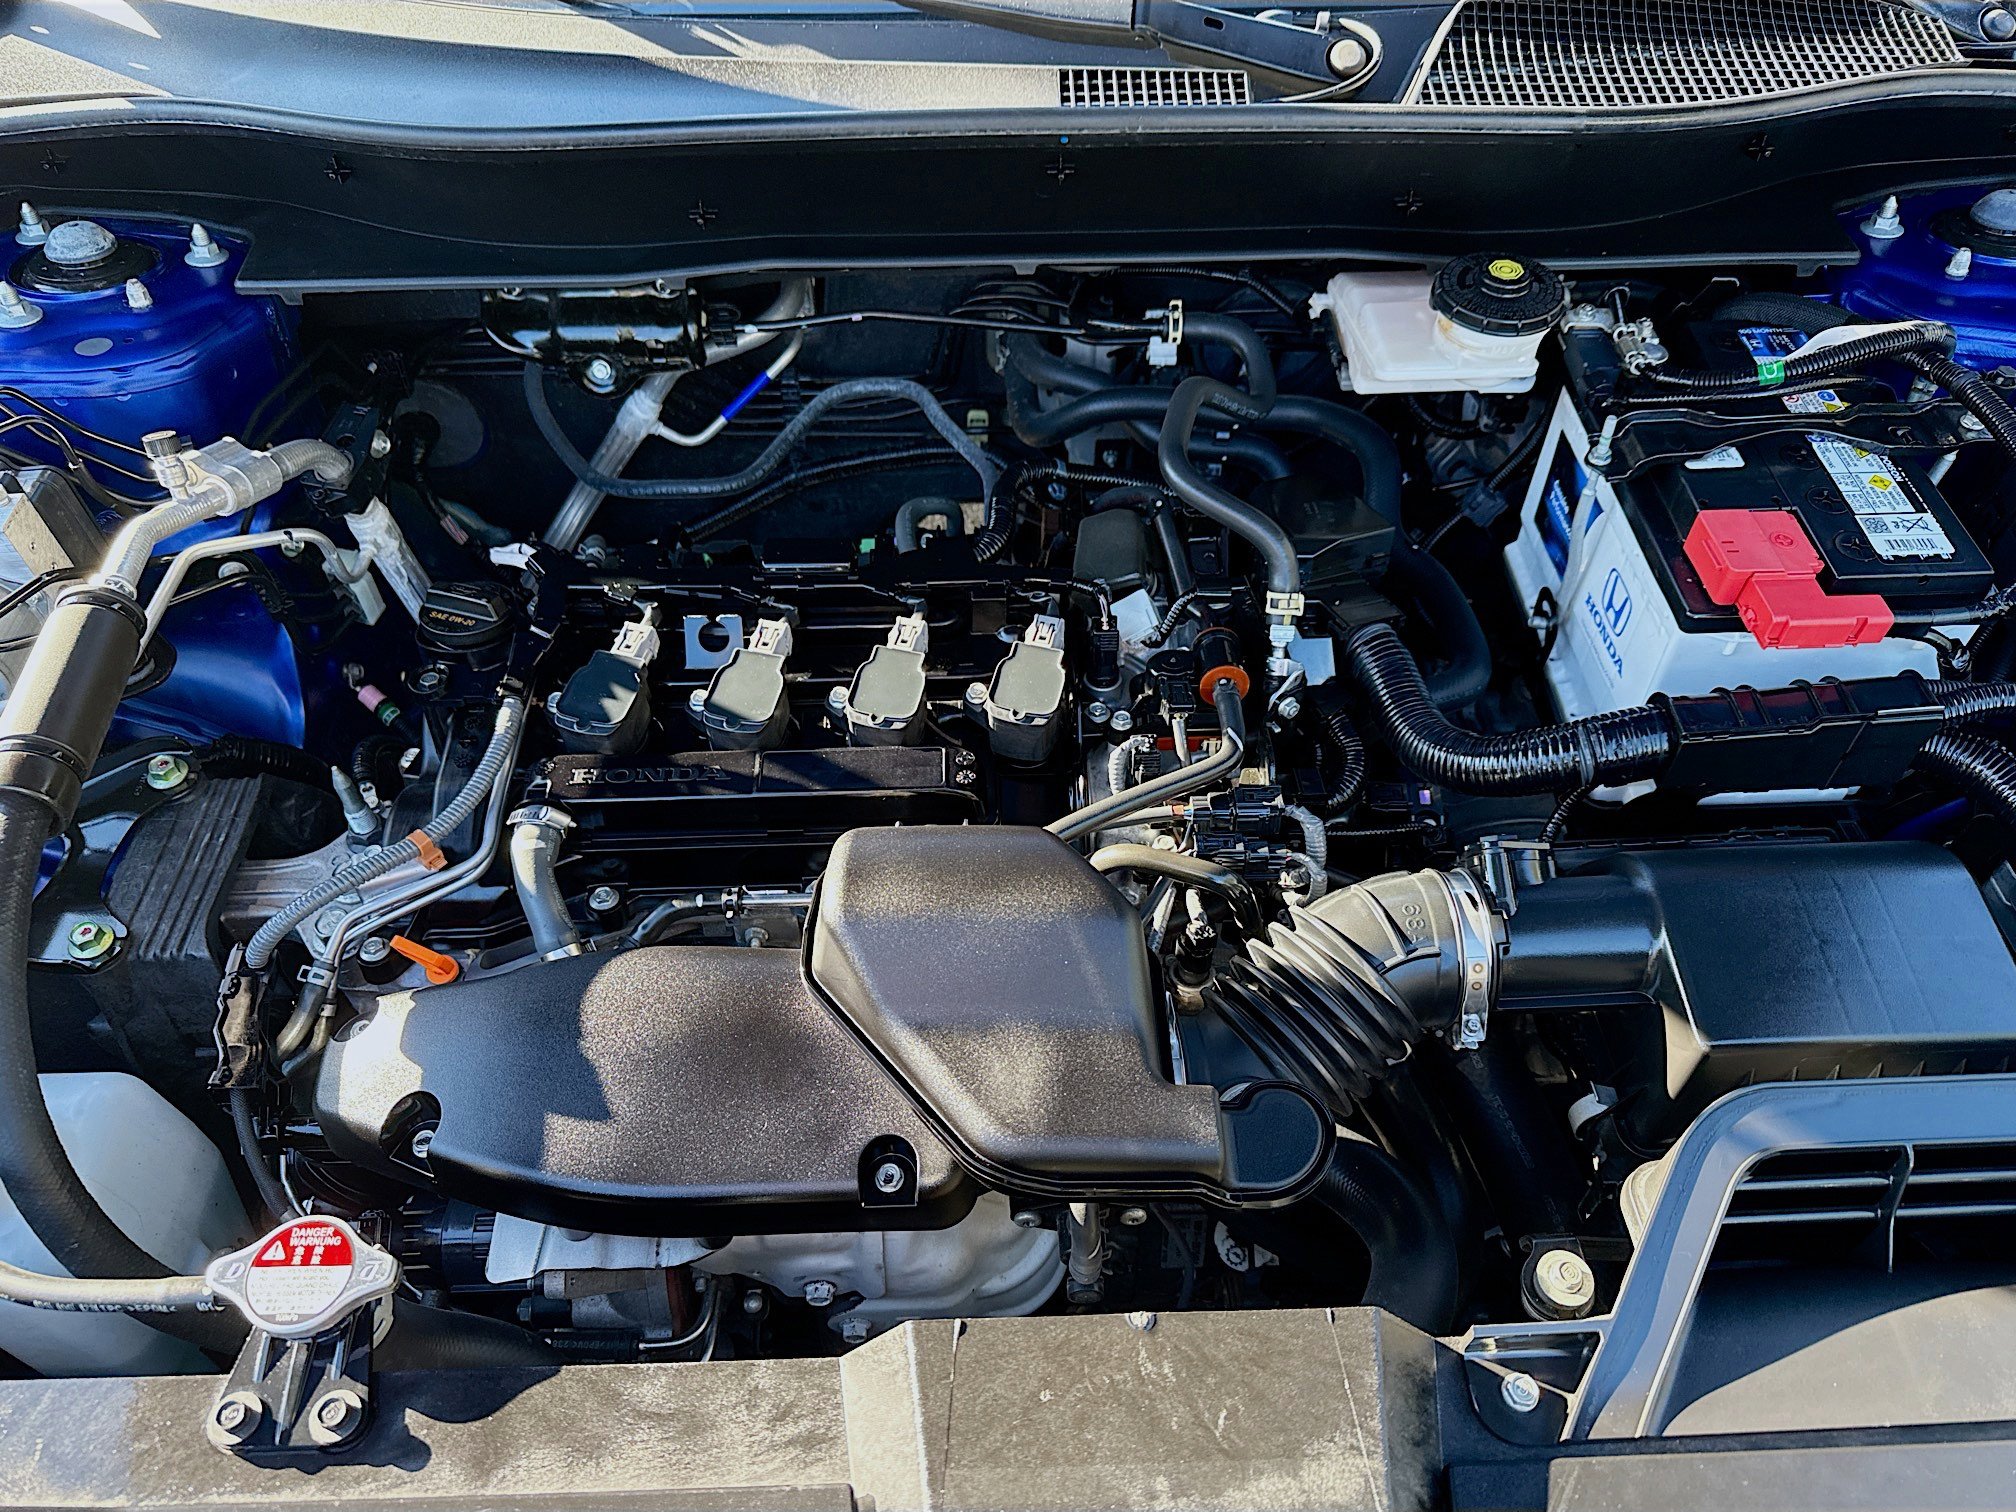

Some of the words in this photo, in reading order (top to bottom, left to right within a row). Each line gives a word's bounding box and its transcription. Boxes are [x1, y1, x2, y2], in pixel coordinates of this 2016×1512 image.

[1880, 455, 1904, 482] POISON
[429, 611, 449, 621] SAE
[449, 615, 476, 627] 0W-20
[1585, 591, 1623, 679] HONDA
[569, 766, 731, 785] HONDA
[291, 1227, 335, 1237] DANGER
[289, 1236, 342, 1247] WARNUNG
